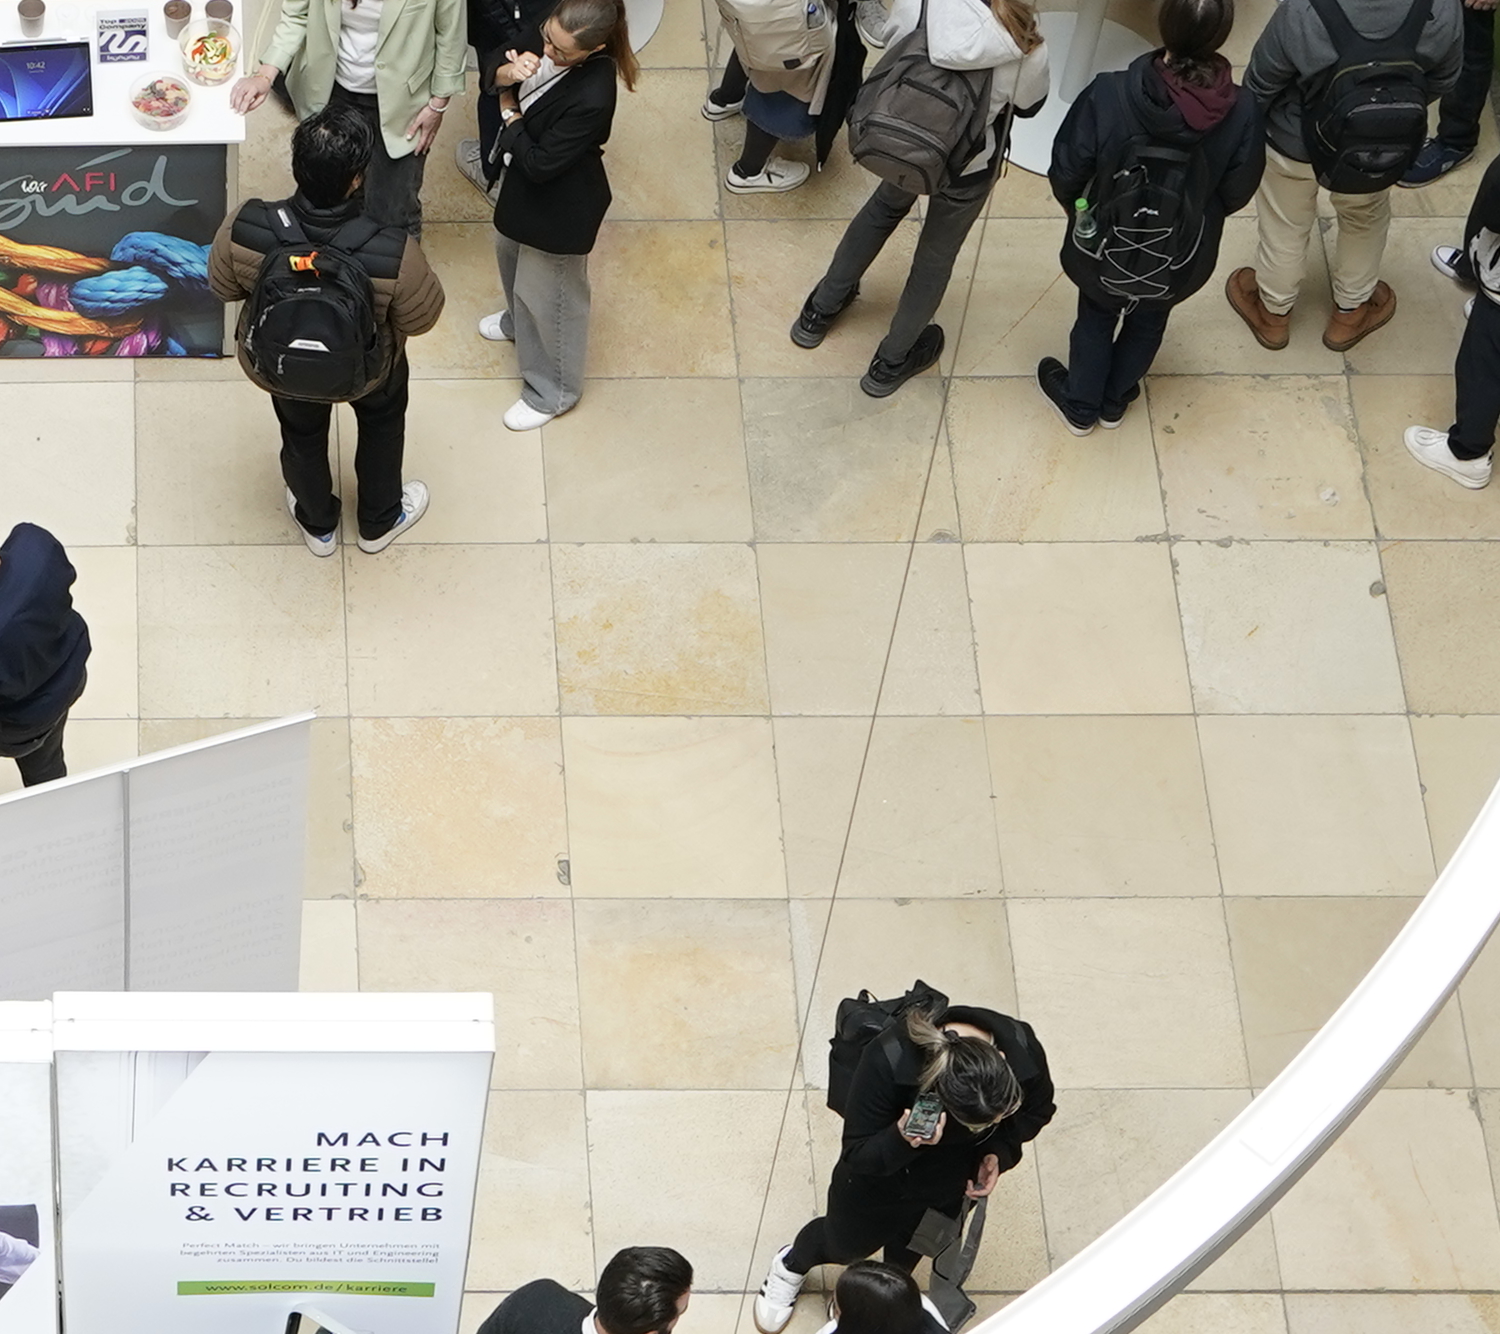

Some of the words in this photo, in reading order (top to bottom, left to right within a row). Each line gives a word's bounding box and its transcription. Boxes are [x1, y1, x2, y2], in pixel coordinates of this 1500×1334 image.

[51, 172, 116, 193] AFI
[316, 1132, 449, 1147] MACH
[167, 1157, 380, 1172] KARRIERE
[401, 1157, 447, 1173] IN
[170, 1182, 444, 1198] RECRUITING
[185, 1205, 215, 1222] &
[234, 1207, 443, 1222] VERTRIEB
[179, 1249, 238, 1258] begehrten
[239, 1249, 307, 1258] Spezialisten
[372, 1249, 441, 1258] Engineering
[292, 1242, 336, 1251] bringen
